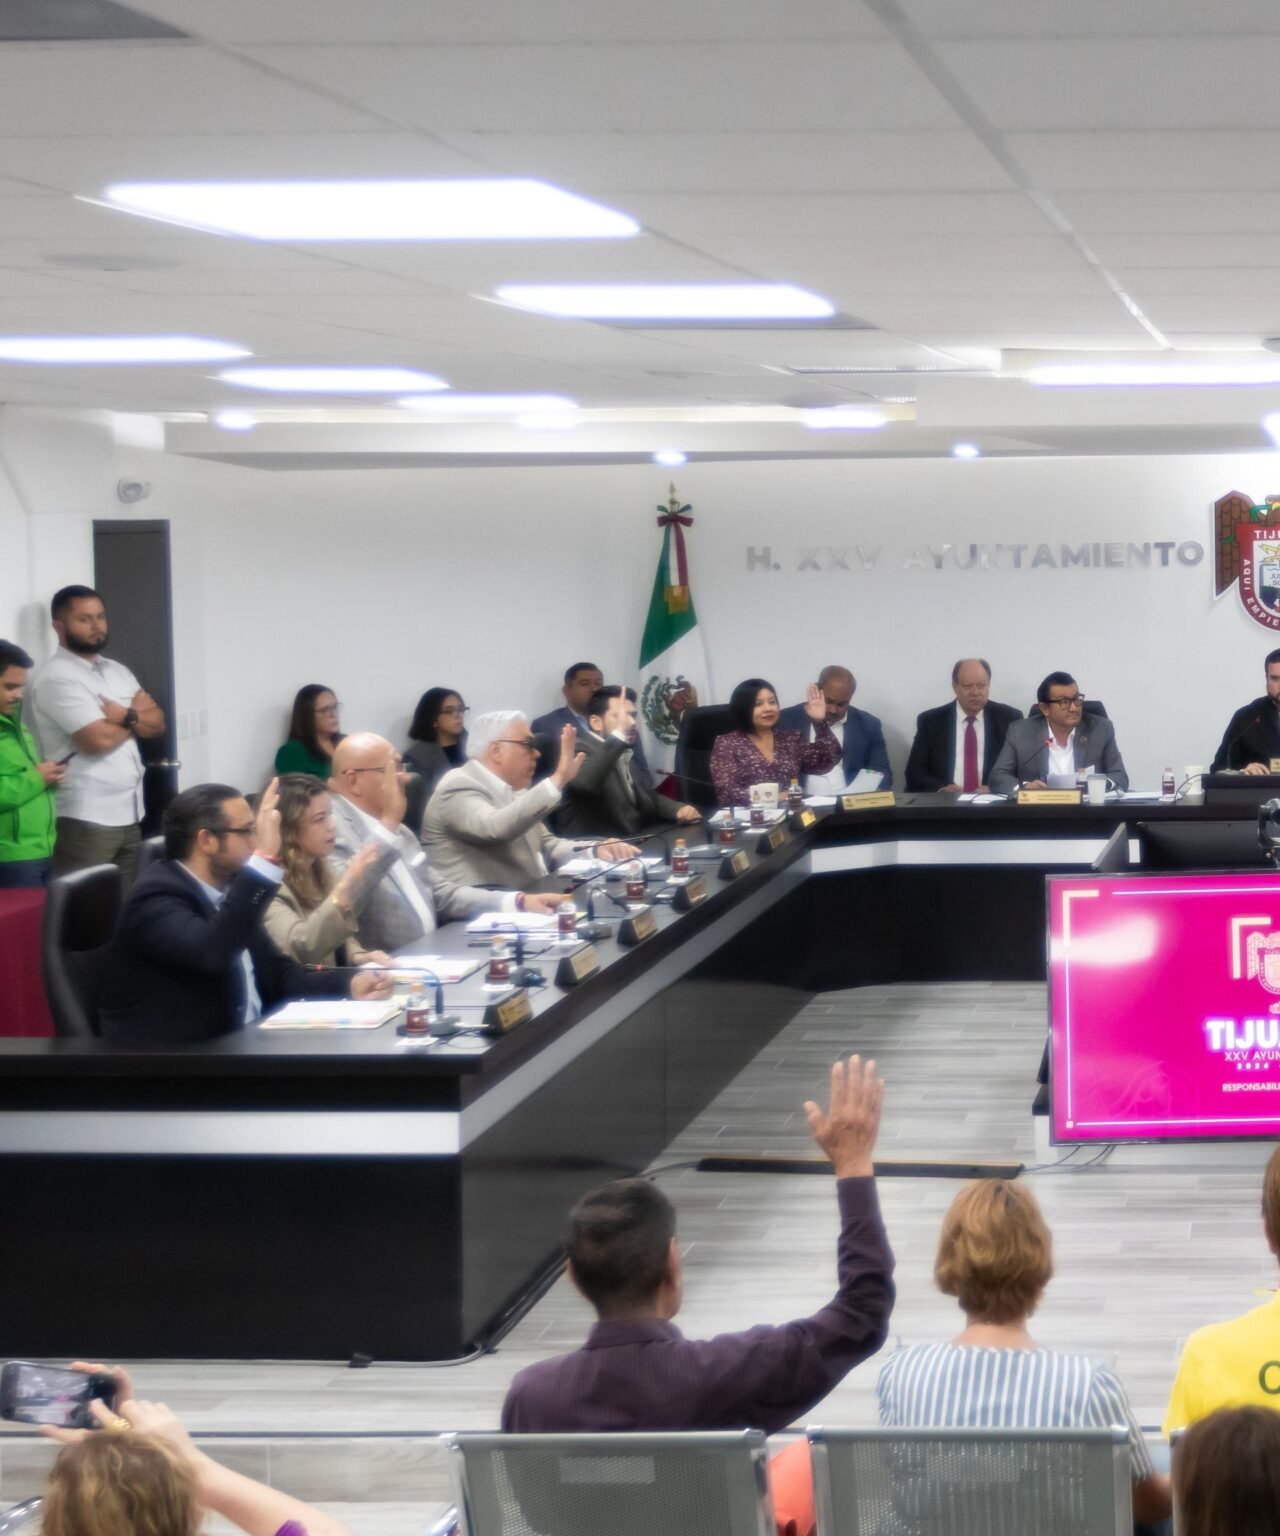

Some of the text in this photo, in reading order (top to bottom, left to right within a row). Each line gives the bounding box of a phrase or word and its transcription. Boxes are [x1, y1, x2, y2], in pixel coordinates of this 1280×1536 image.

[746, 540, 1205, 571] H. XXV AYUNTAMIENTO
[1225, 1051, 1249, 1061] XXV
[1236, 1062, 1269, 1070] 2024
